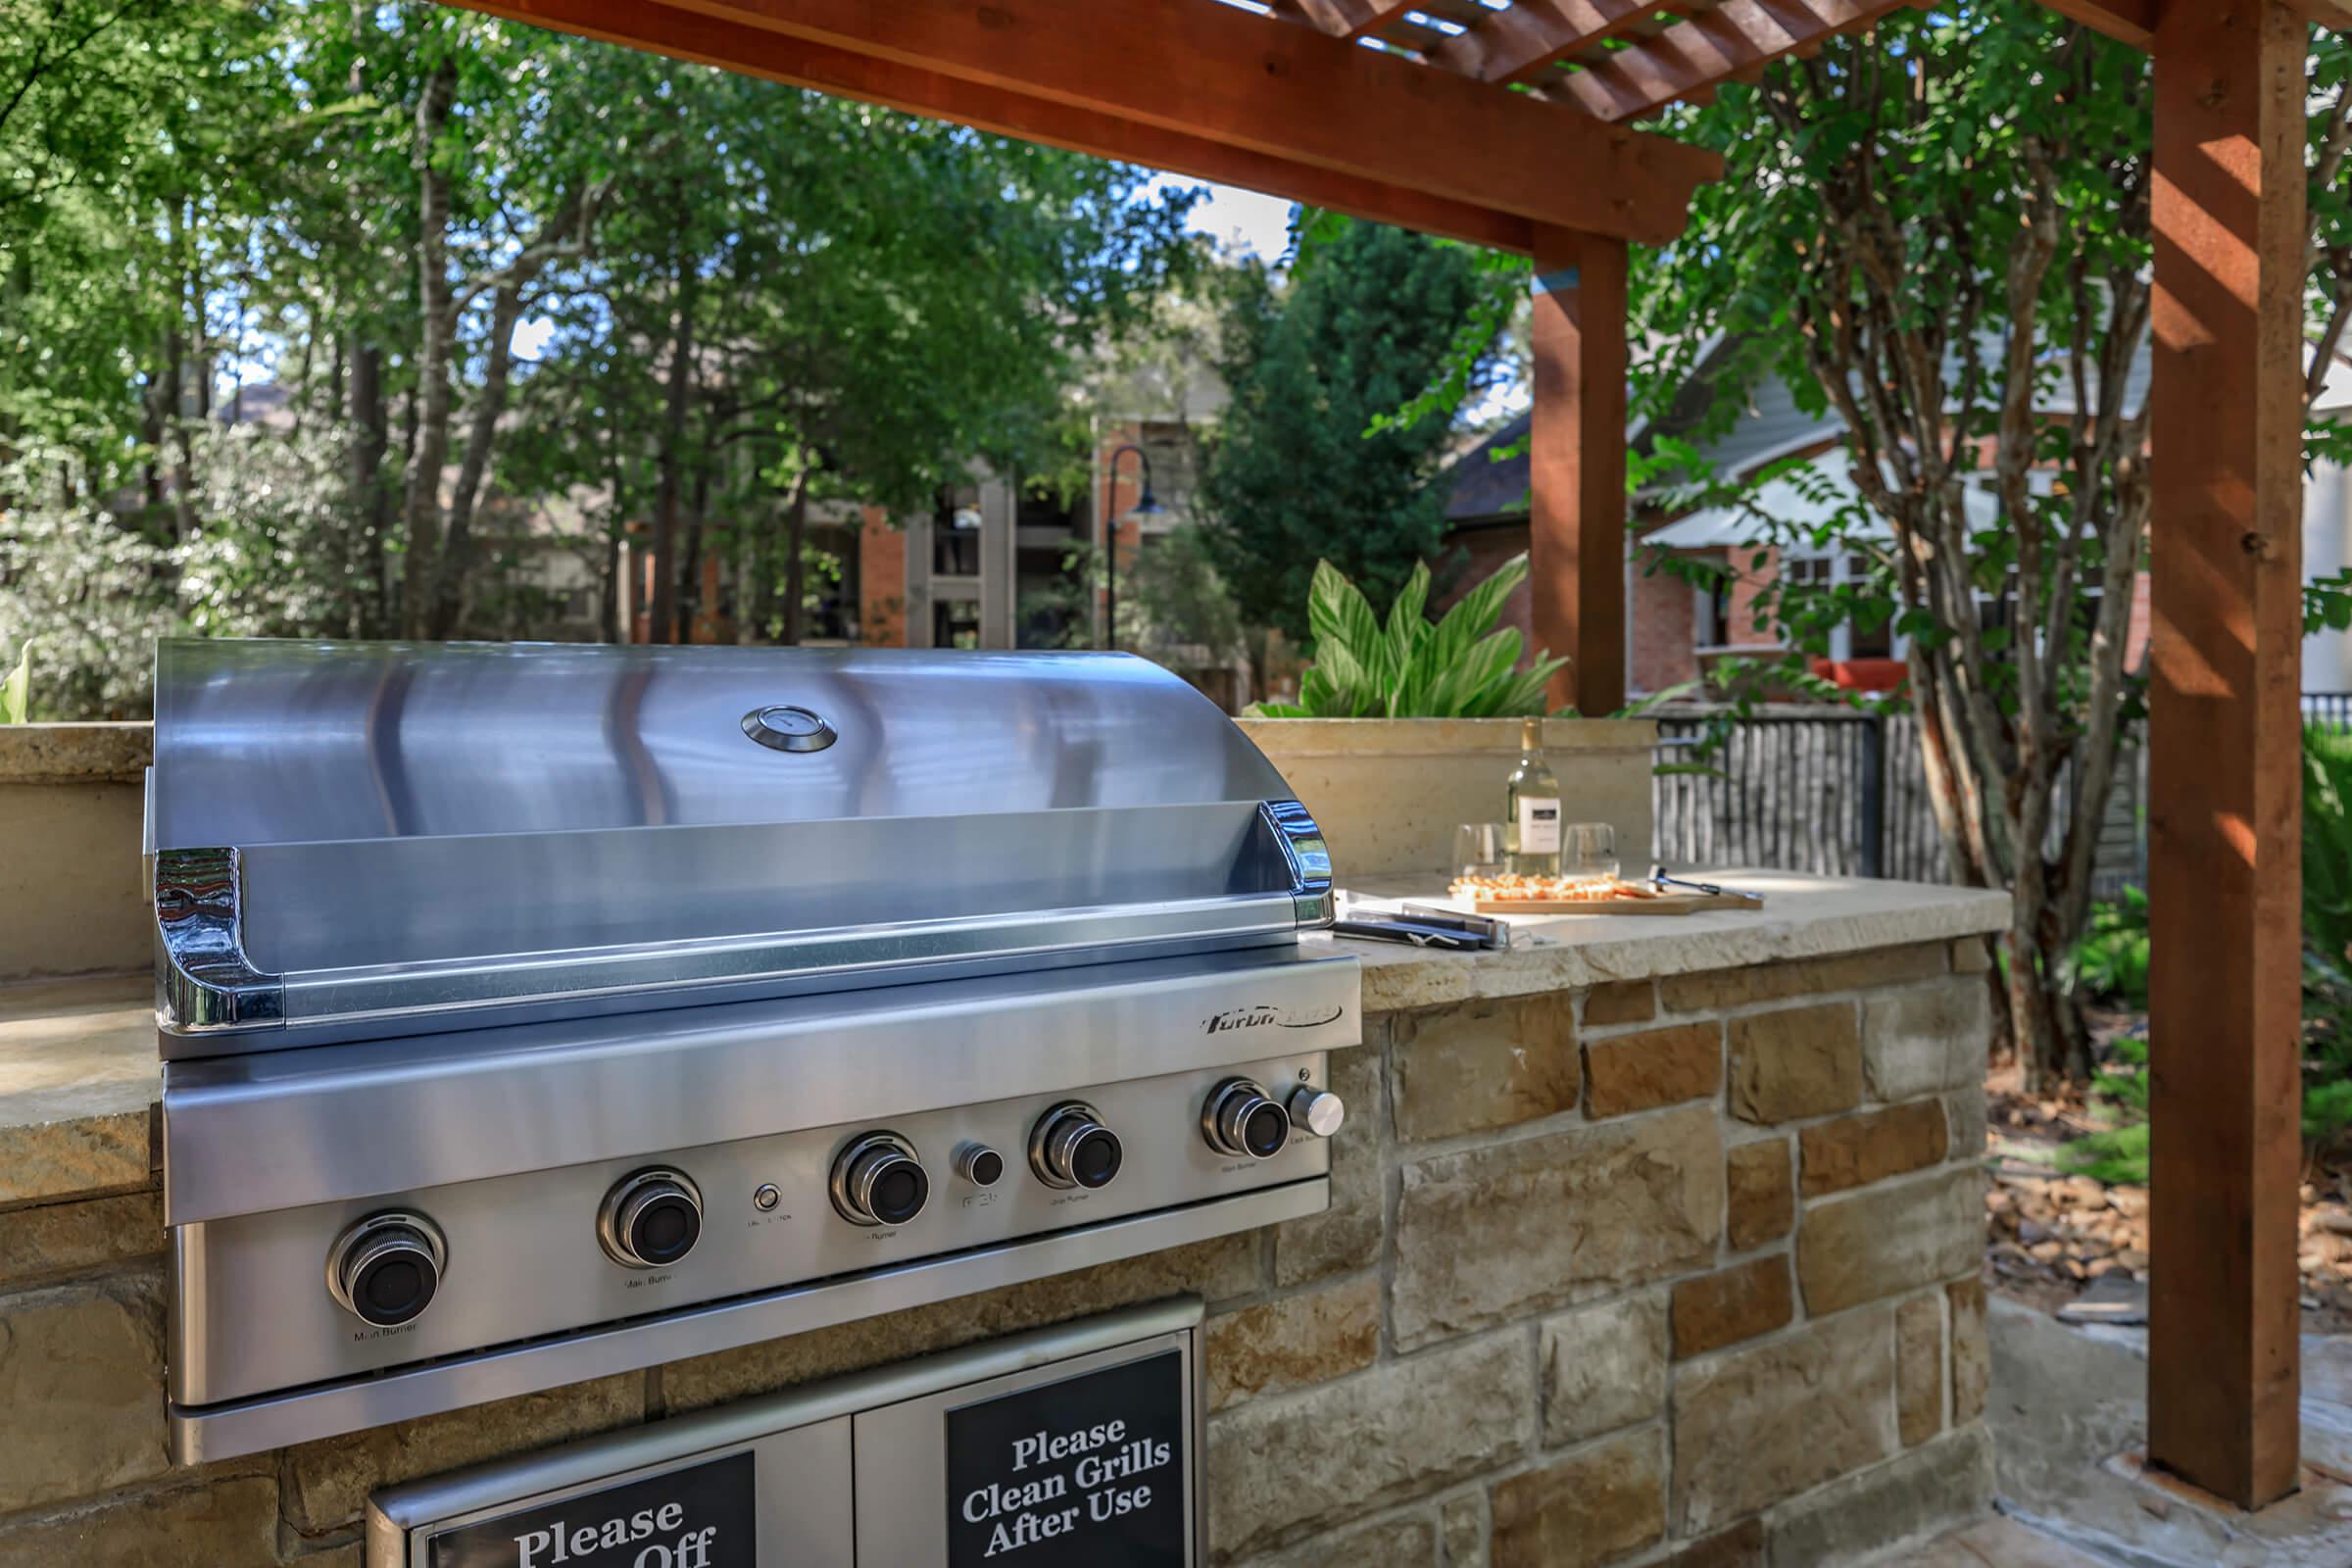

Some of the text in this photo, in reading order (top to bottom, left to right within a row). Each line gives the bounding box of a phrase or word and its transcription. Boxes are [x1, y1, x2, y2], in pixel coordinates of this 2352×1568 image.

[1011, 1419, 1126, 1472] Please
[961, 1438, 1171, 1523] Clean Grills
[514, 1501, 684, 1568] Please
[633, 1525, 717, 1568] Off
[983, 1485, 1152, 1557] After Use
